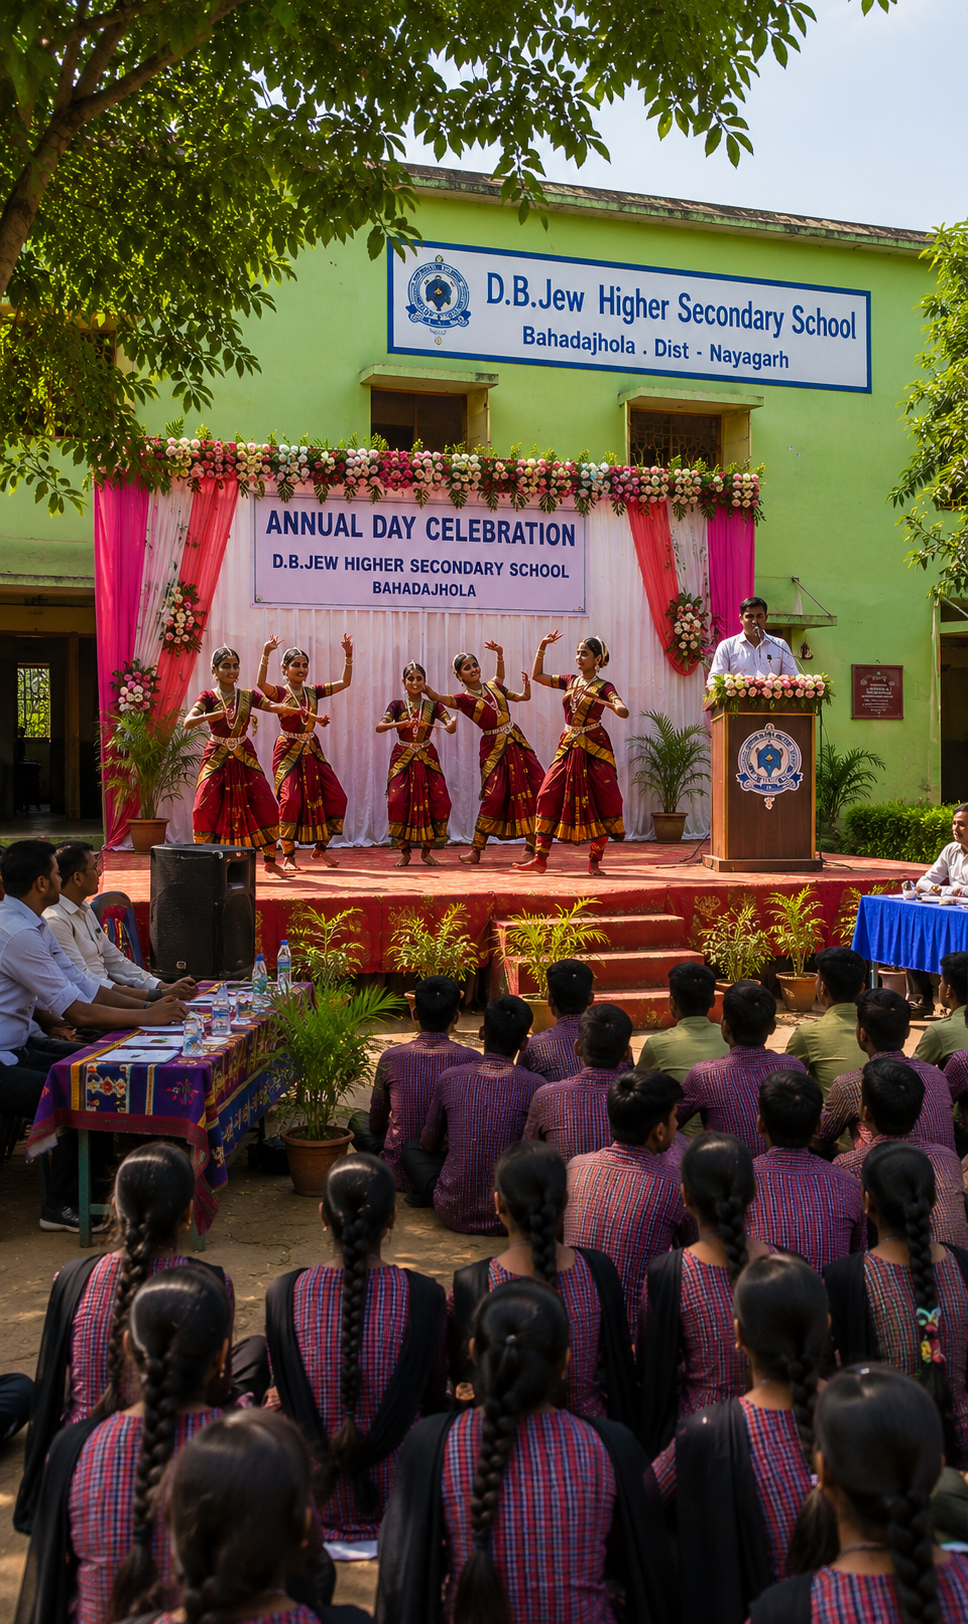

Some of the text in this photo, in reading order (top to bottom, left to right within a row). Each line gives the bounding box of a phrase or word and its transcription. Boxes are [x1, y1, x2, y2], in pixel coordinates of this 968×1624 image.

[486, 271, 585, 313] D.B.Jew
[598, 283, 670, 325] Higher
[677, 292, 785, 339] Secondary
[791, 304, 857, 340] School
[522, 325, 636, 356] Bahadajhola
[654, 338, 690, 360] Dist
[709, 343, 789, 371] Nayagarh
[265, 509, 575, 547] ANNUAL DAY CELEBRATION
[272, 553, 570, 579] D.B.JEW HIGHER SECONDARY SCHOOL
[372, 580, 477, 598] BAHADAJHOLA
